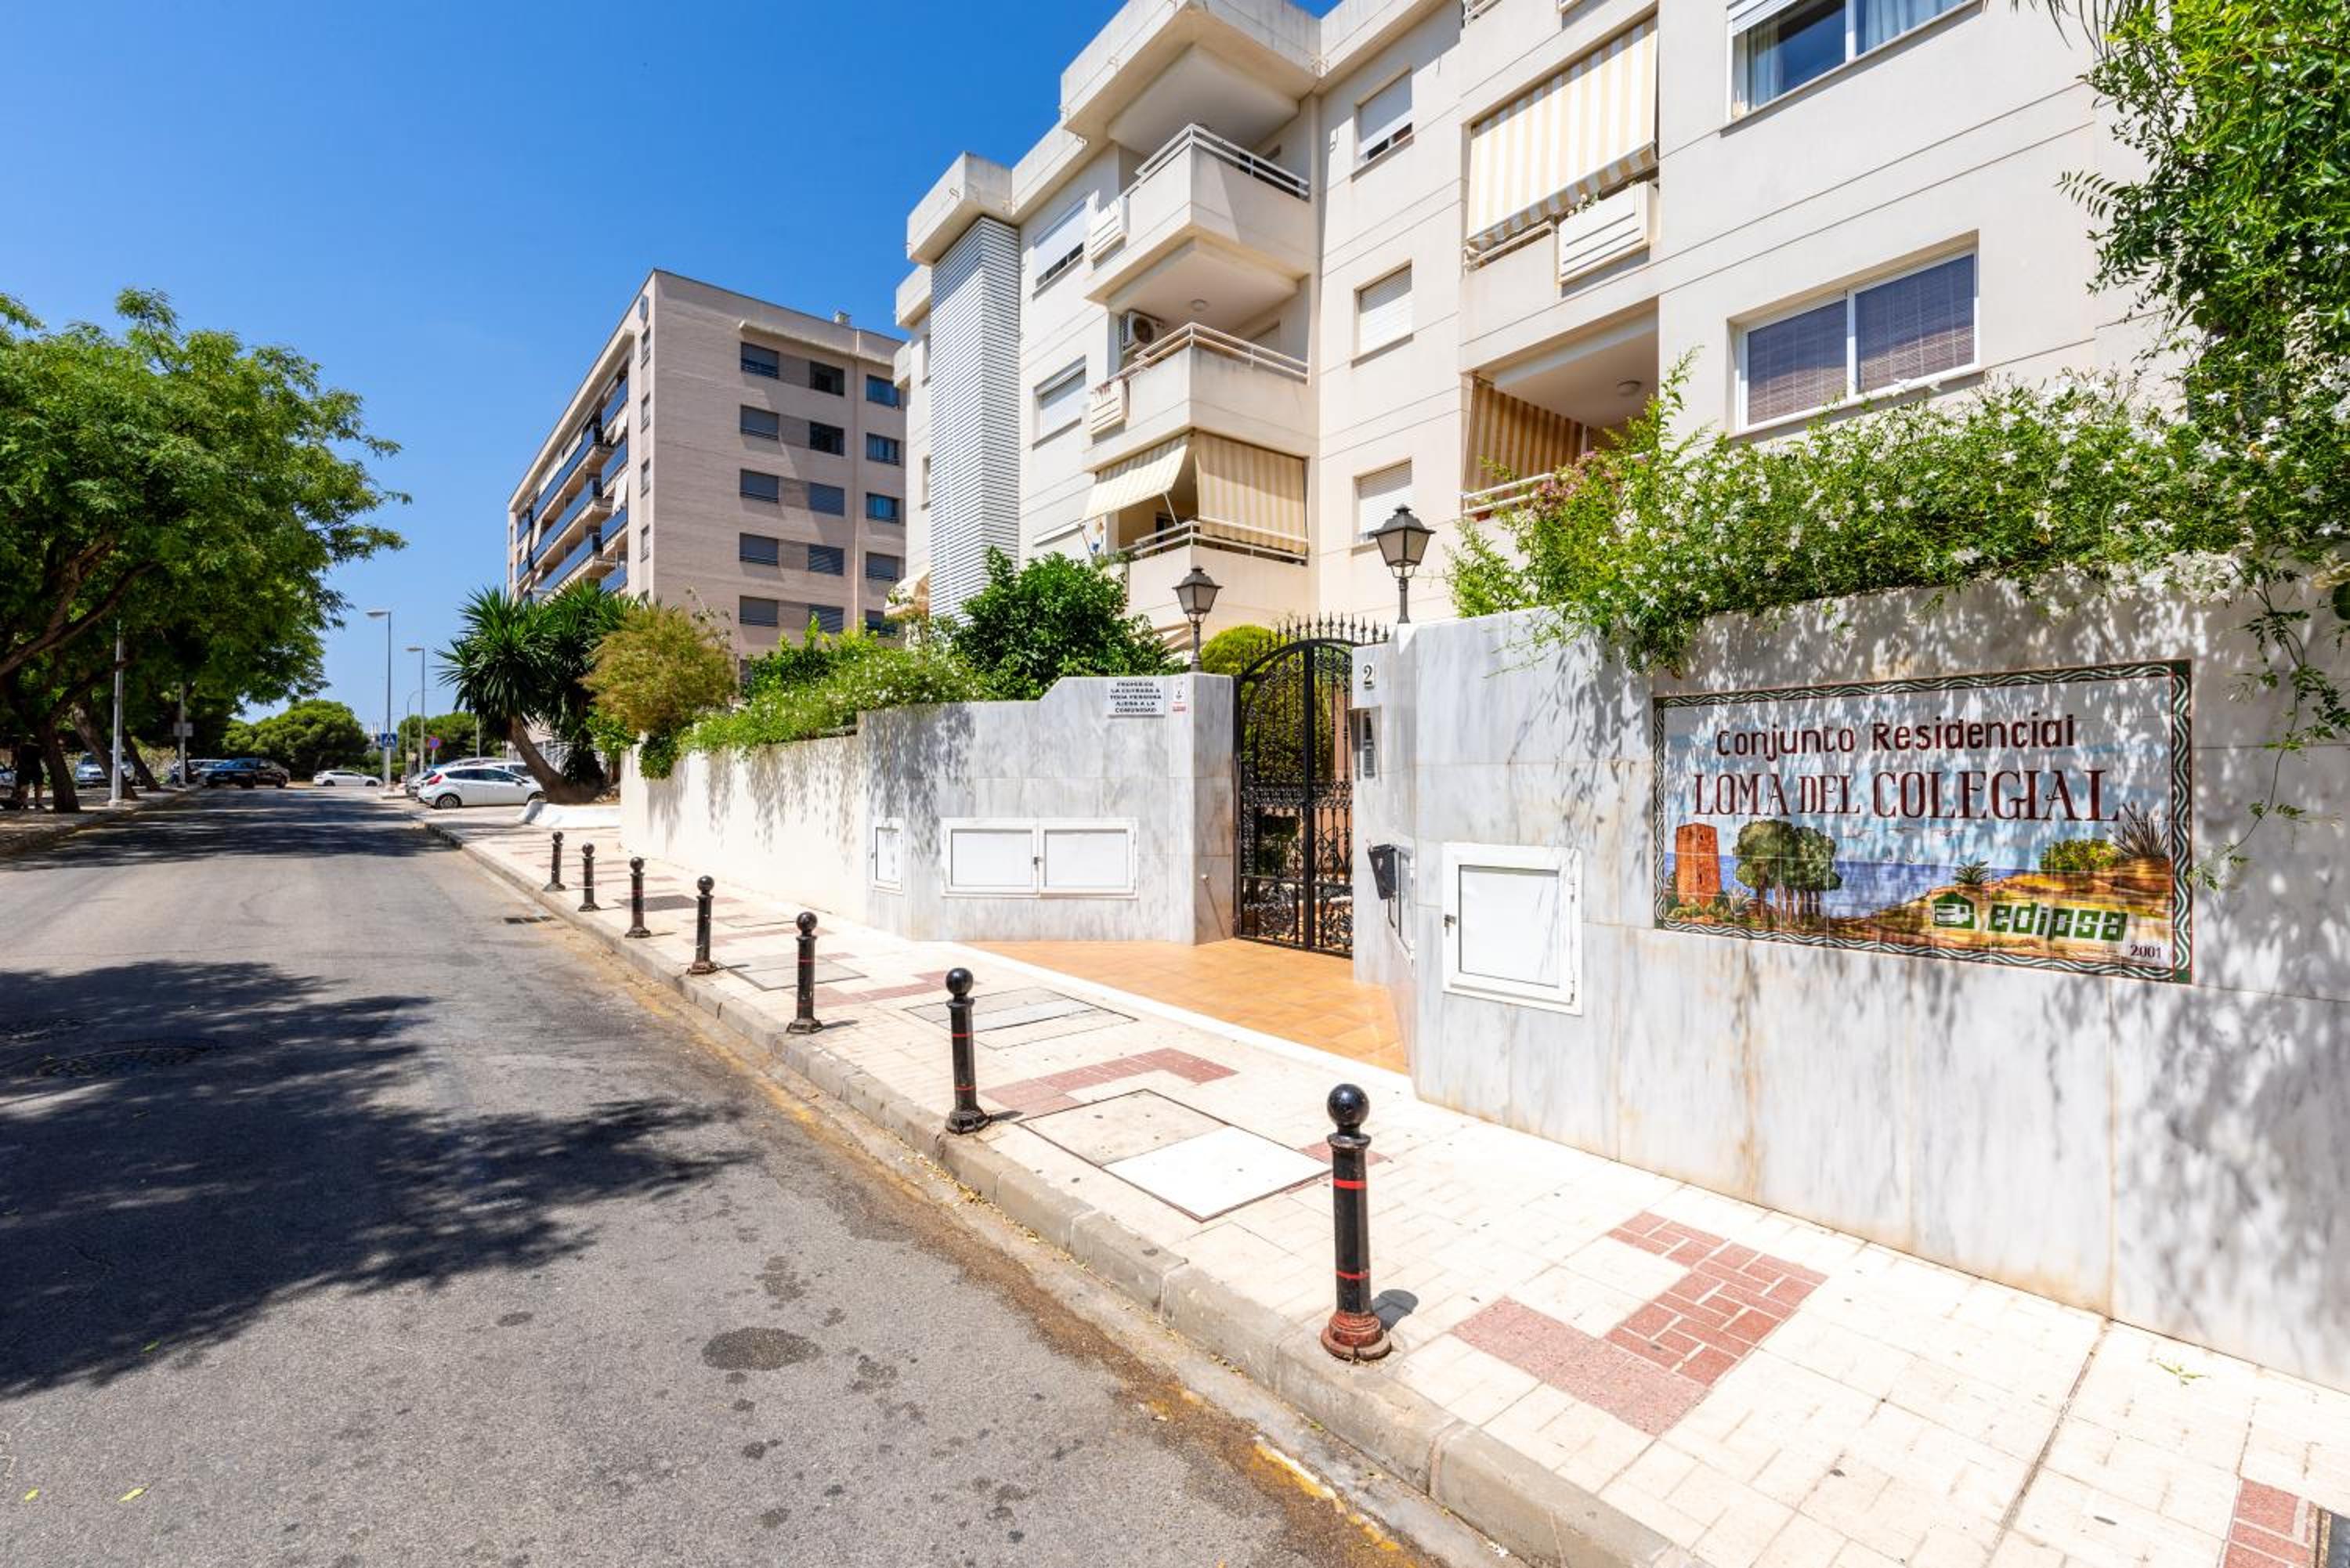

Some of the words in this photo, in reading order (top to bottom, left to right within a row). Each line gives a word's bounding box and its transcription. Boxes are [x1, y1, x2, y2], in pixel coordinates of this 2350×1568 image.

[1364, 665, 1373, 686] 2
[1871, 711, 2075, 751] Residencial
[1694, 773, 1790, 816] LOMA
[1798, 775, 1860, 815] DEL
[1871, 769, 2120, 822] COLEGIAL
[1989, 901, 2128, 942] edipsa
[2130, 944, 2162, 959] 2001
